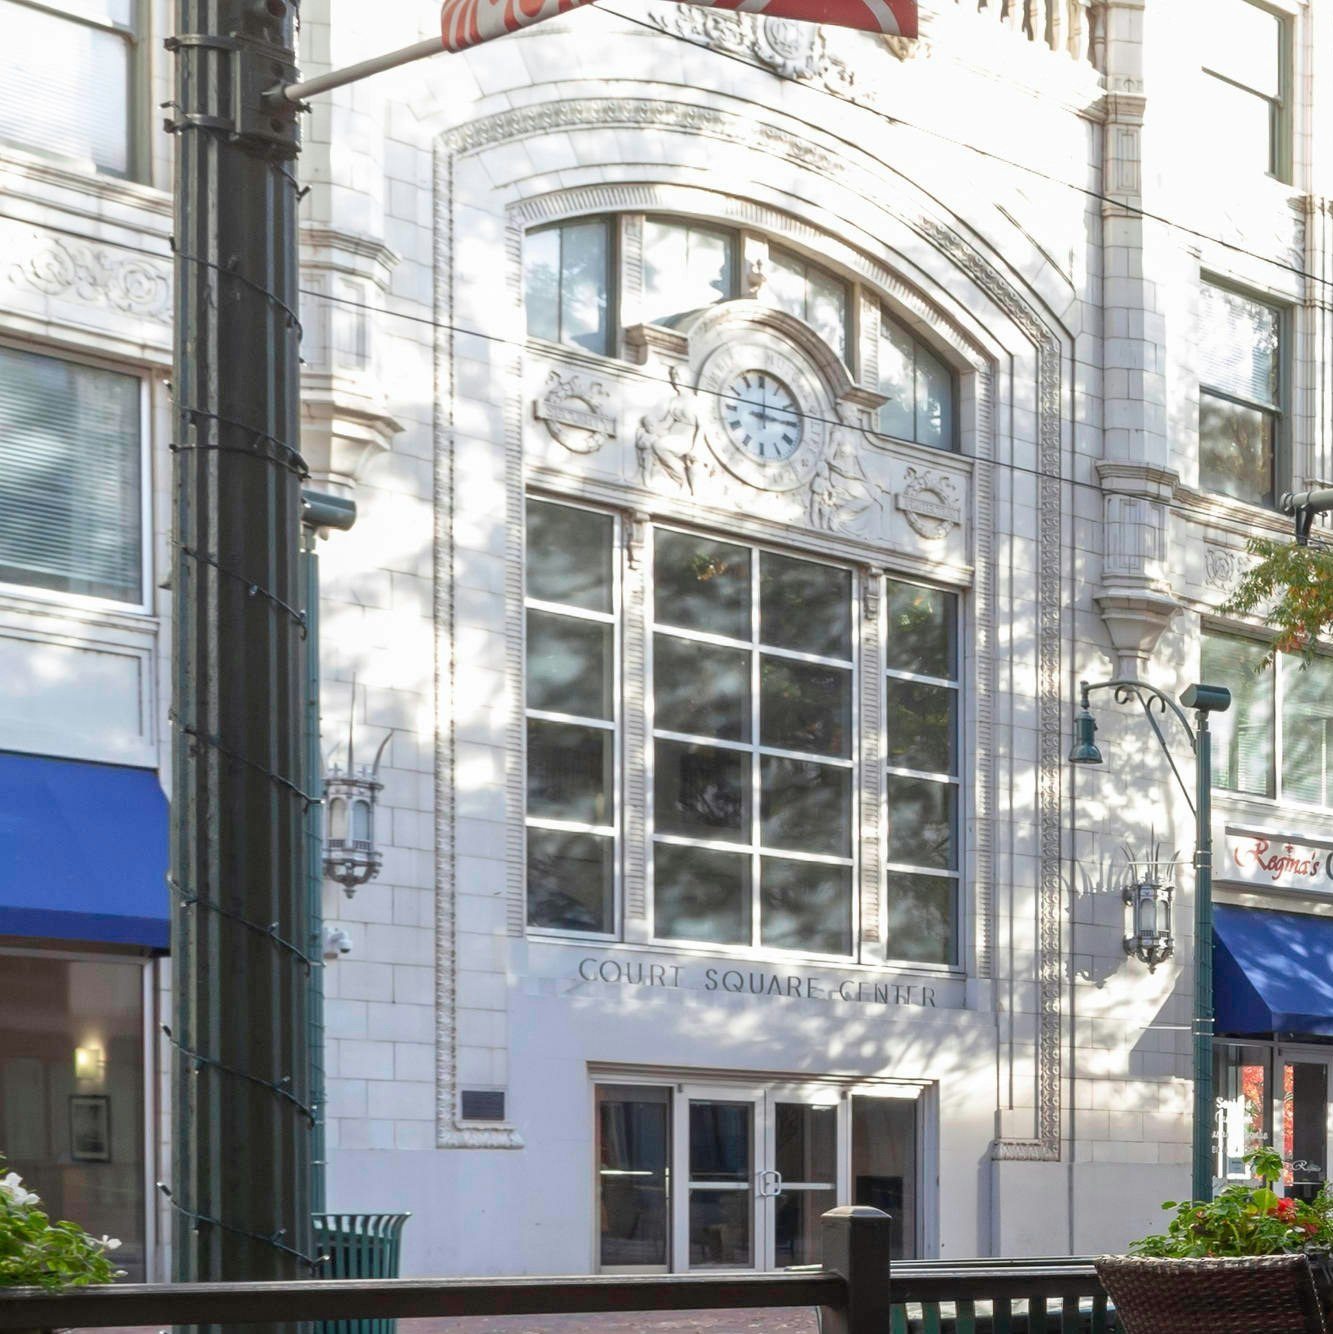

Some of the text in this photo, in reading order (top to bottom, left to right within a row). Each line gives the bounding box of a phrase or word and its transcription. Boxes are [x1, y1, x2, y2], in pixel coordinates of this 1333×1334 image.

[1233, 839, 1321, 880] Regina's
[579, 957, 936, 1008] COURT SQUARE CENTER
